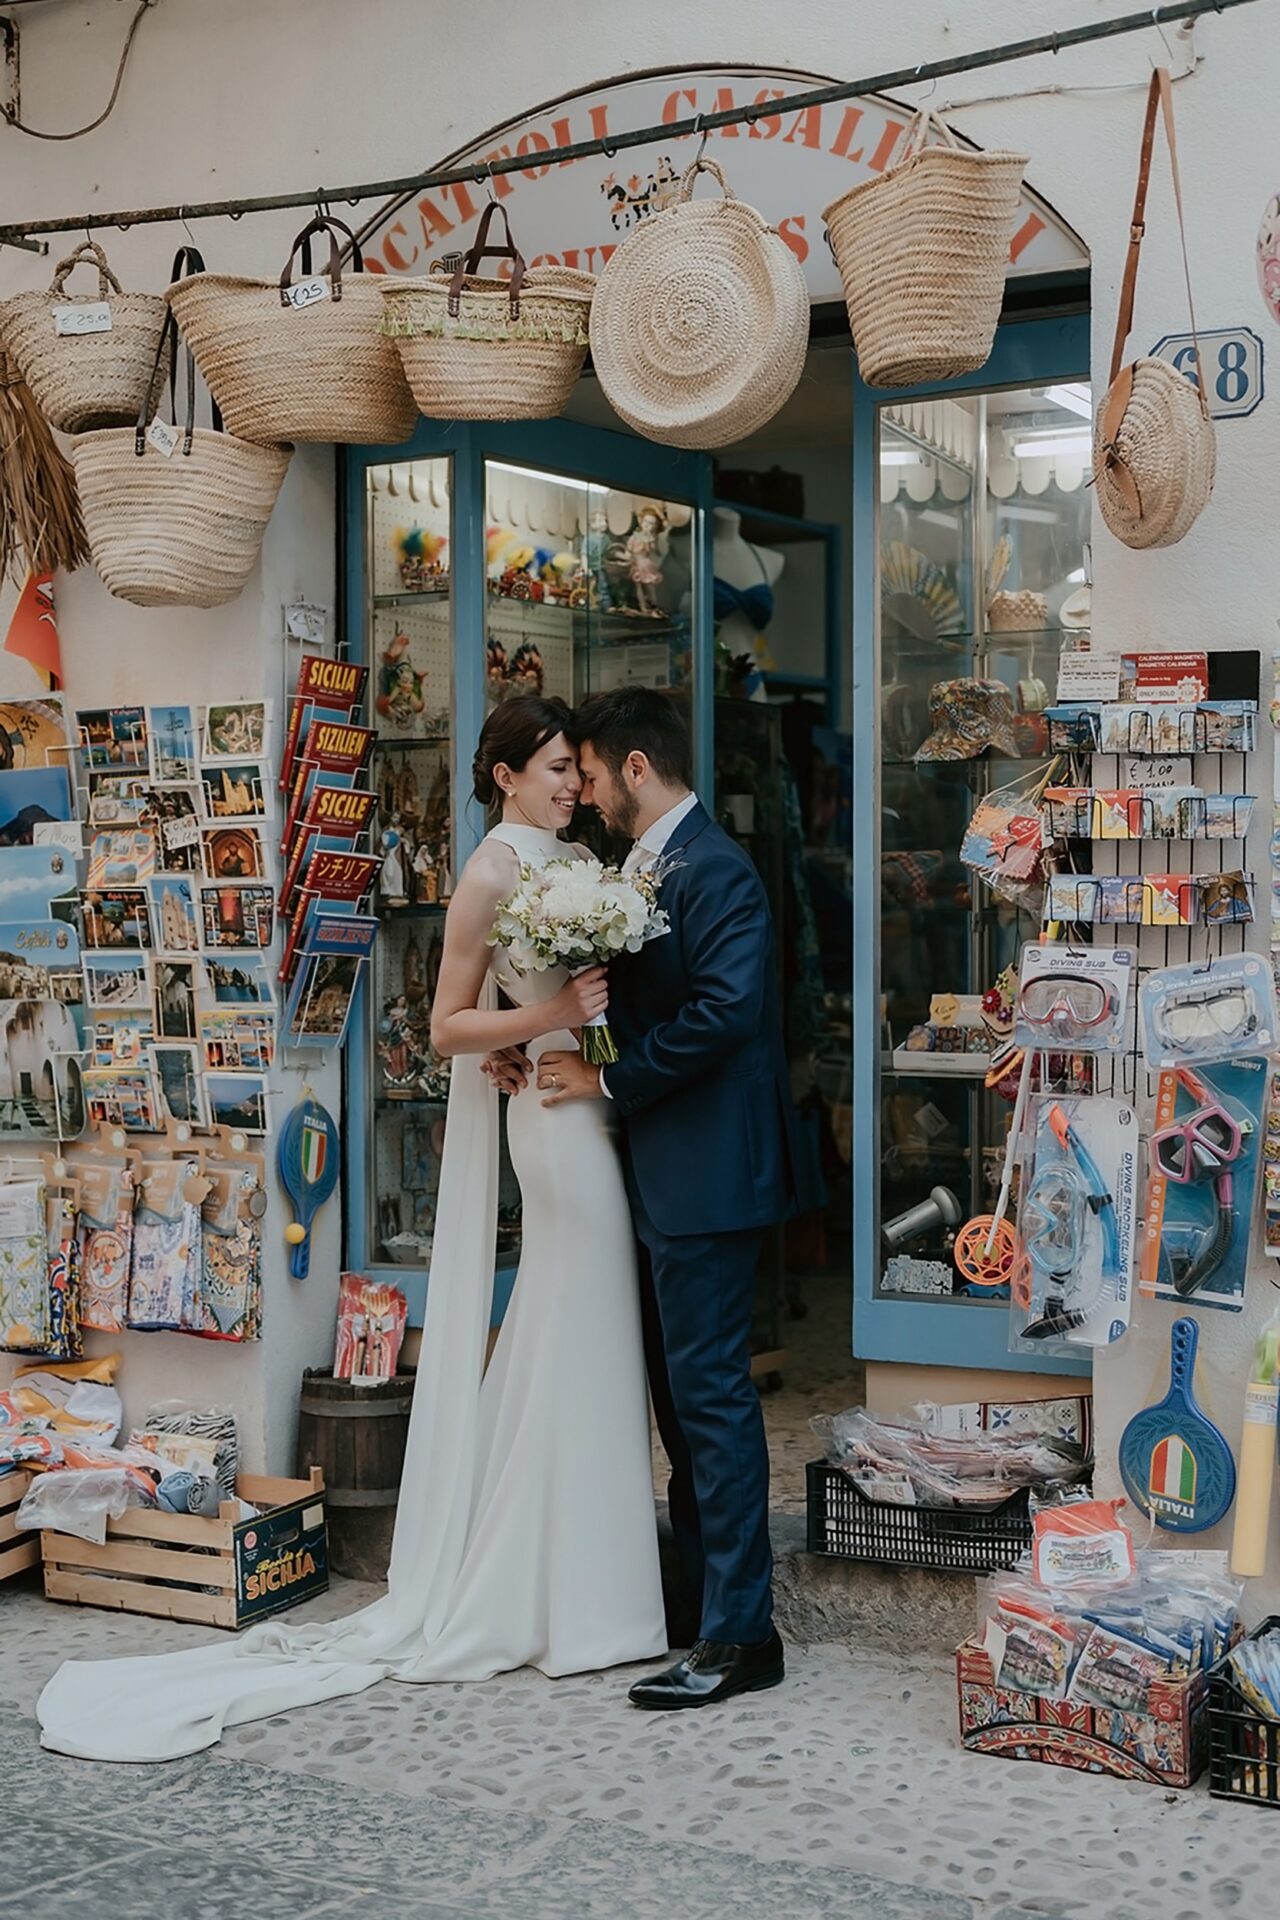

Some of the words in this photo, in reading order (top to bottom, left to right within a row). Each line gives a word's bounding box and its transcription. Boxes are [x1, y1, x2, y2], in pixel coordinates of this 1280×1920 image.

[309, 661, 357, 692] SICILIA
[1167, 660, 1198, 668] CALENDAR
[316, 726, 367, 755] SIZILIEN
[317, 791, 369, 820] SICILE
[317, 856, 371, 881] シチリア
[1049, 959, 1082, 967] DIVING
[1085, 960, 1106, 968] SUB
[303, 1115, 328, 1132] ITALIA
[1123, 1152, 1133, 1194] DIVING
[1119, 1196, 1132, 1274] SNORKELING
[1118, 1275, 1128, 1302] SUB
[1148, 1495, 1195, 1519] ITALIA
[245, 1552, 316, 1600] SICILIA
